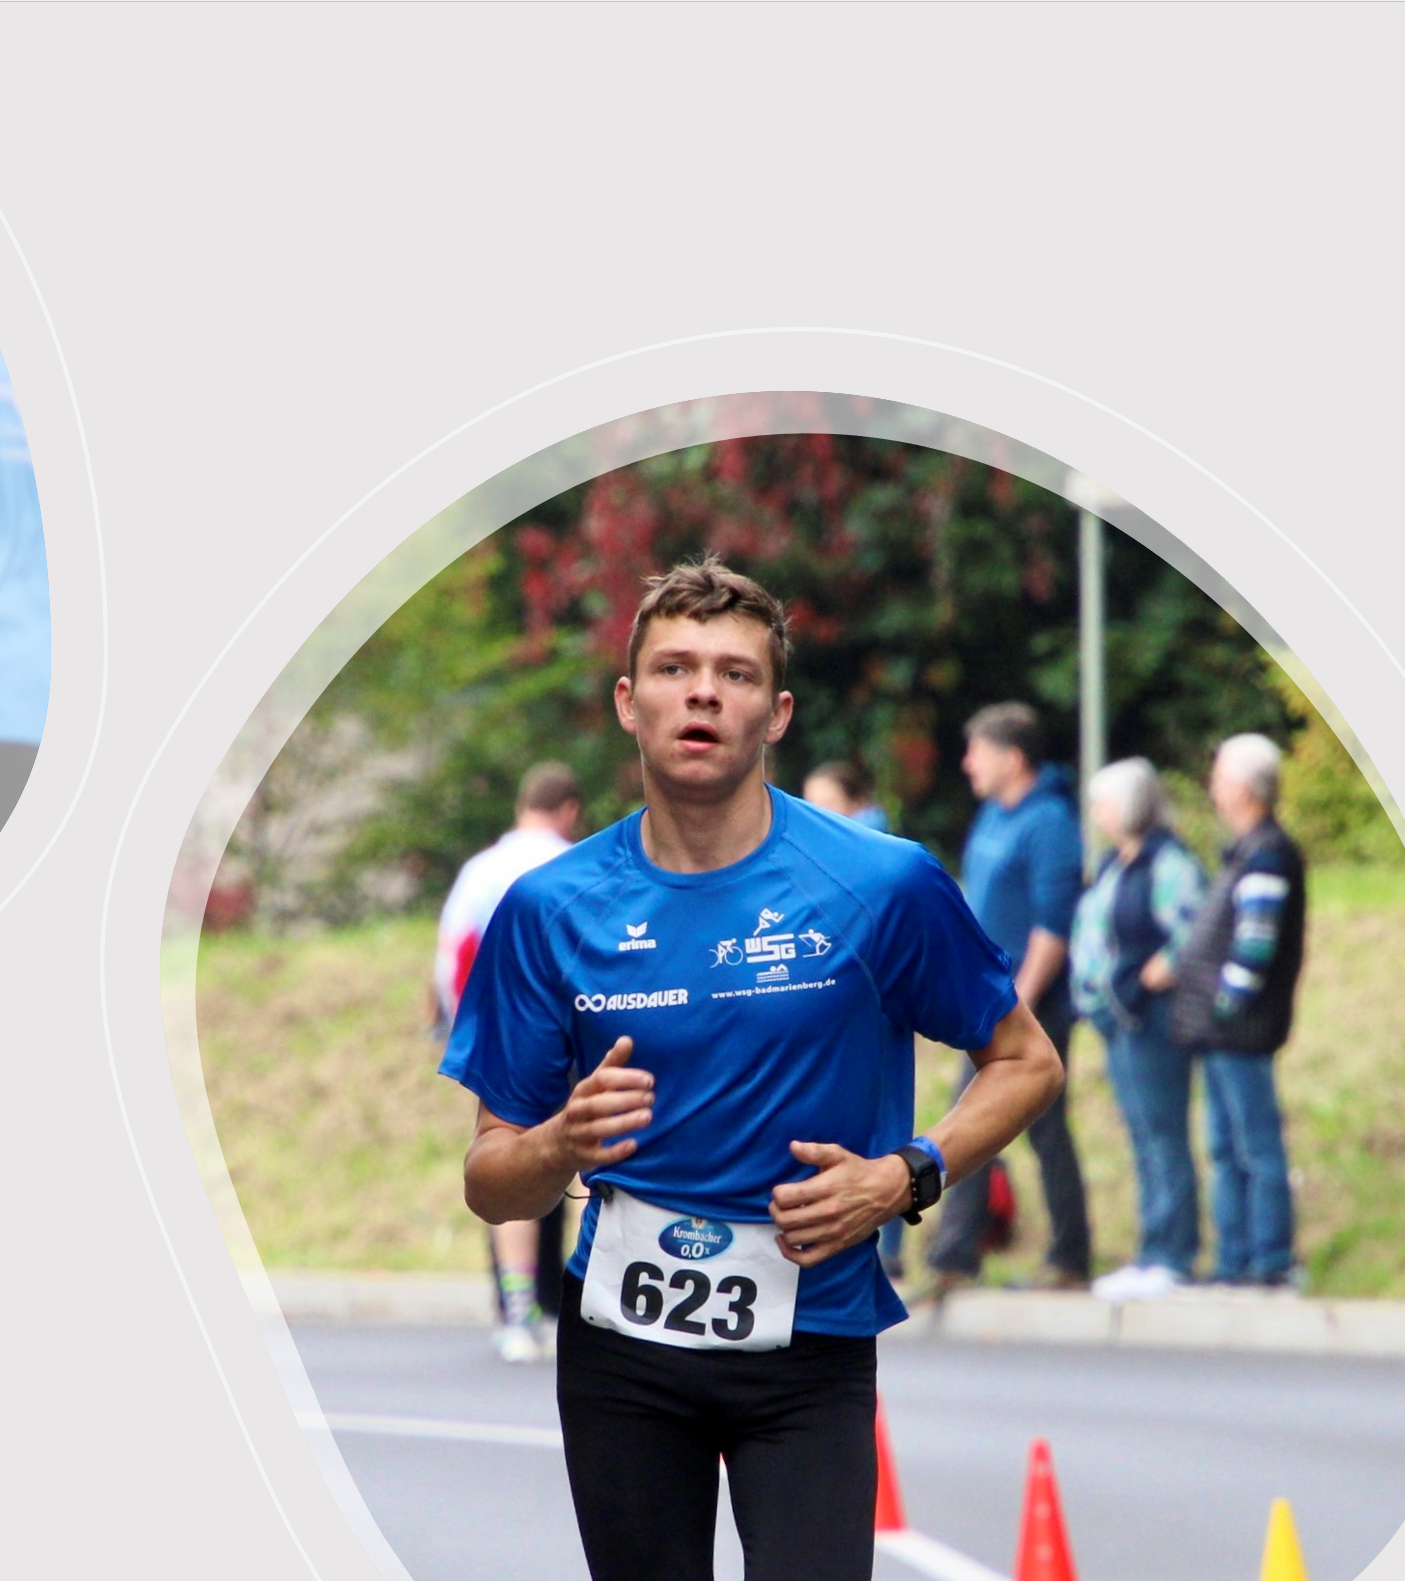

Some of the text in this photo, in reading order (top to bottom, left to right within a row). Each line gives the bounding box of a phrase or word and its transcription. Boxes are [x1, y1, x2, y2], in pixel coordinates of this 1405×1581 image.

[618, 938, 657, 951] erima
[744, 933, 796, 963] WSG
[711, 978, 836, 999] www.wsg-badmarienberg.de
[673, 1225, 722, 1244] Krombacher
[620, 1261, 757, 1341] 623
